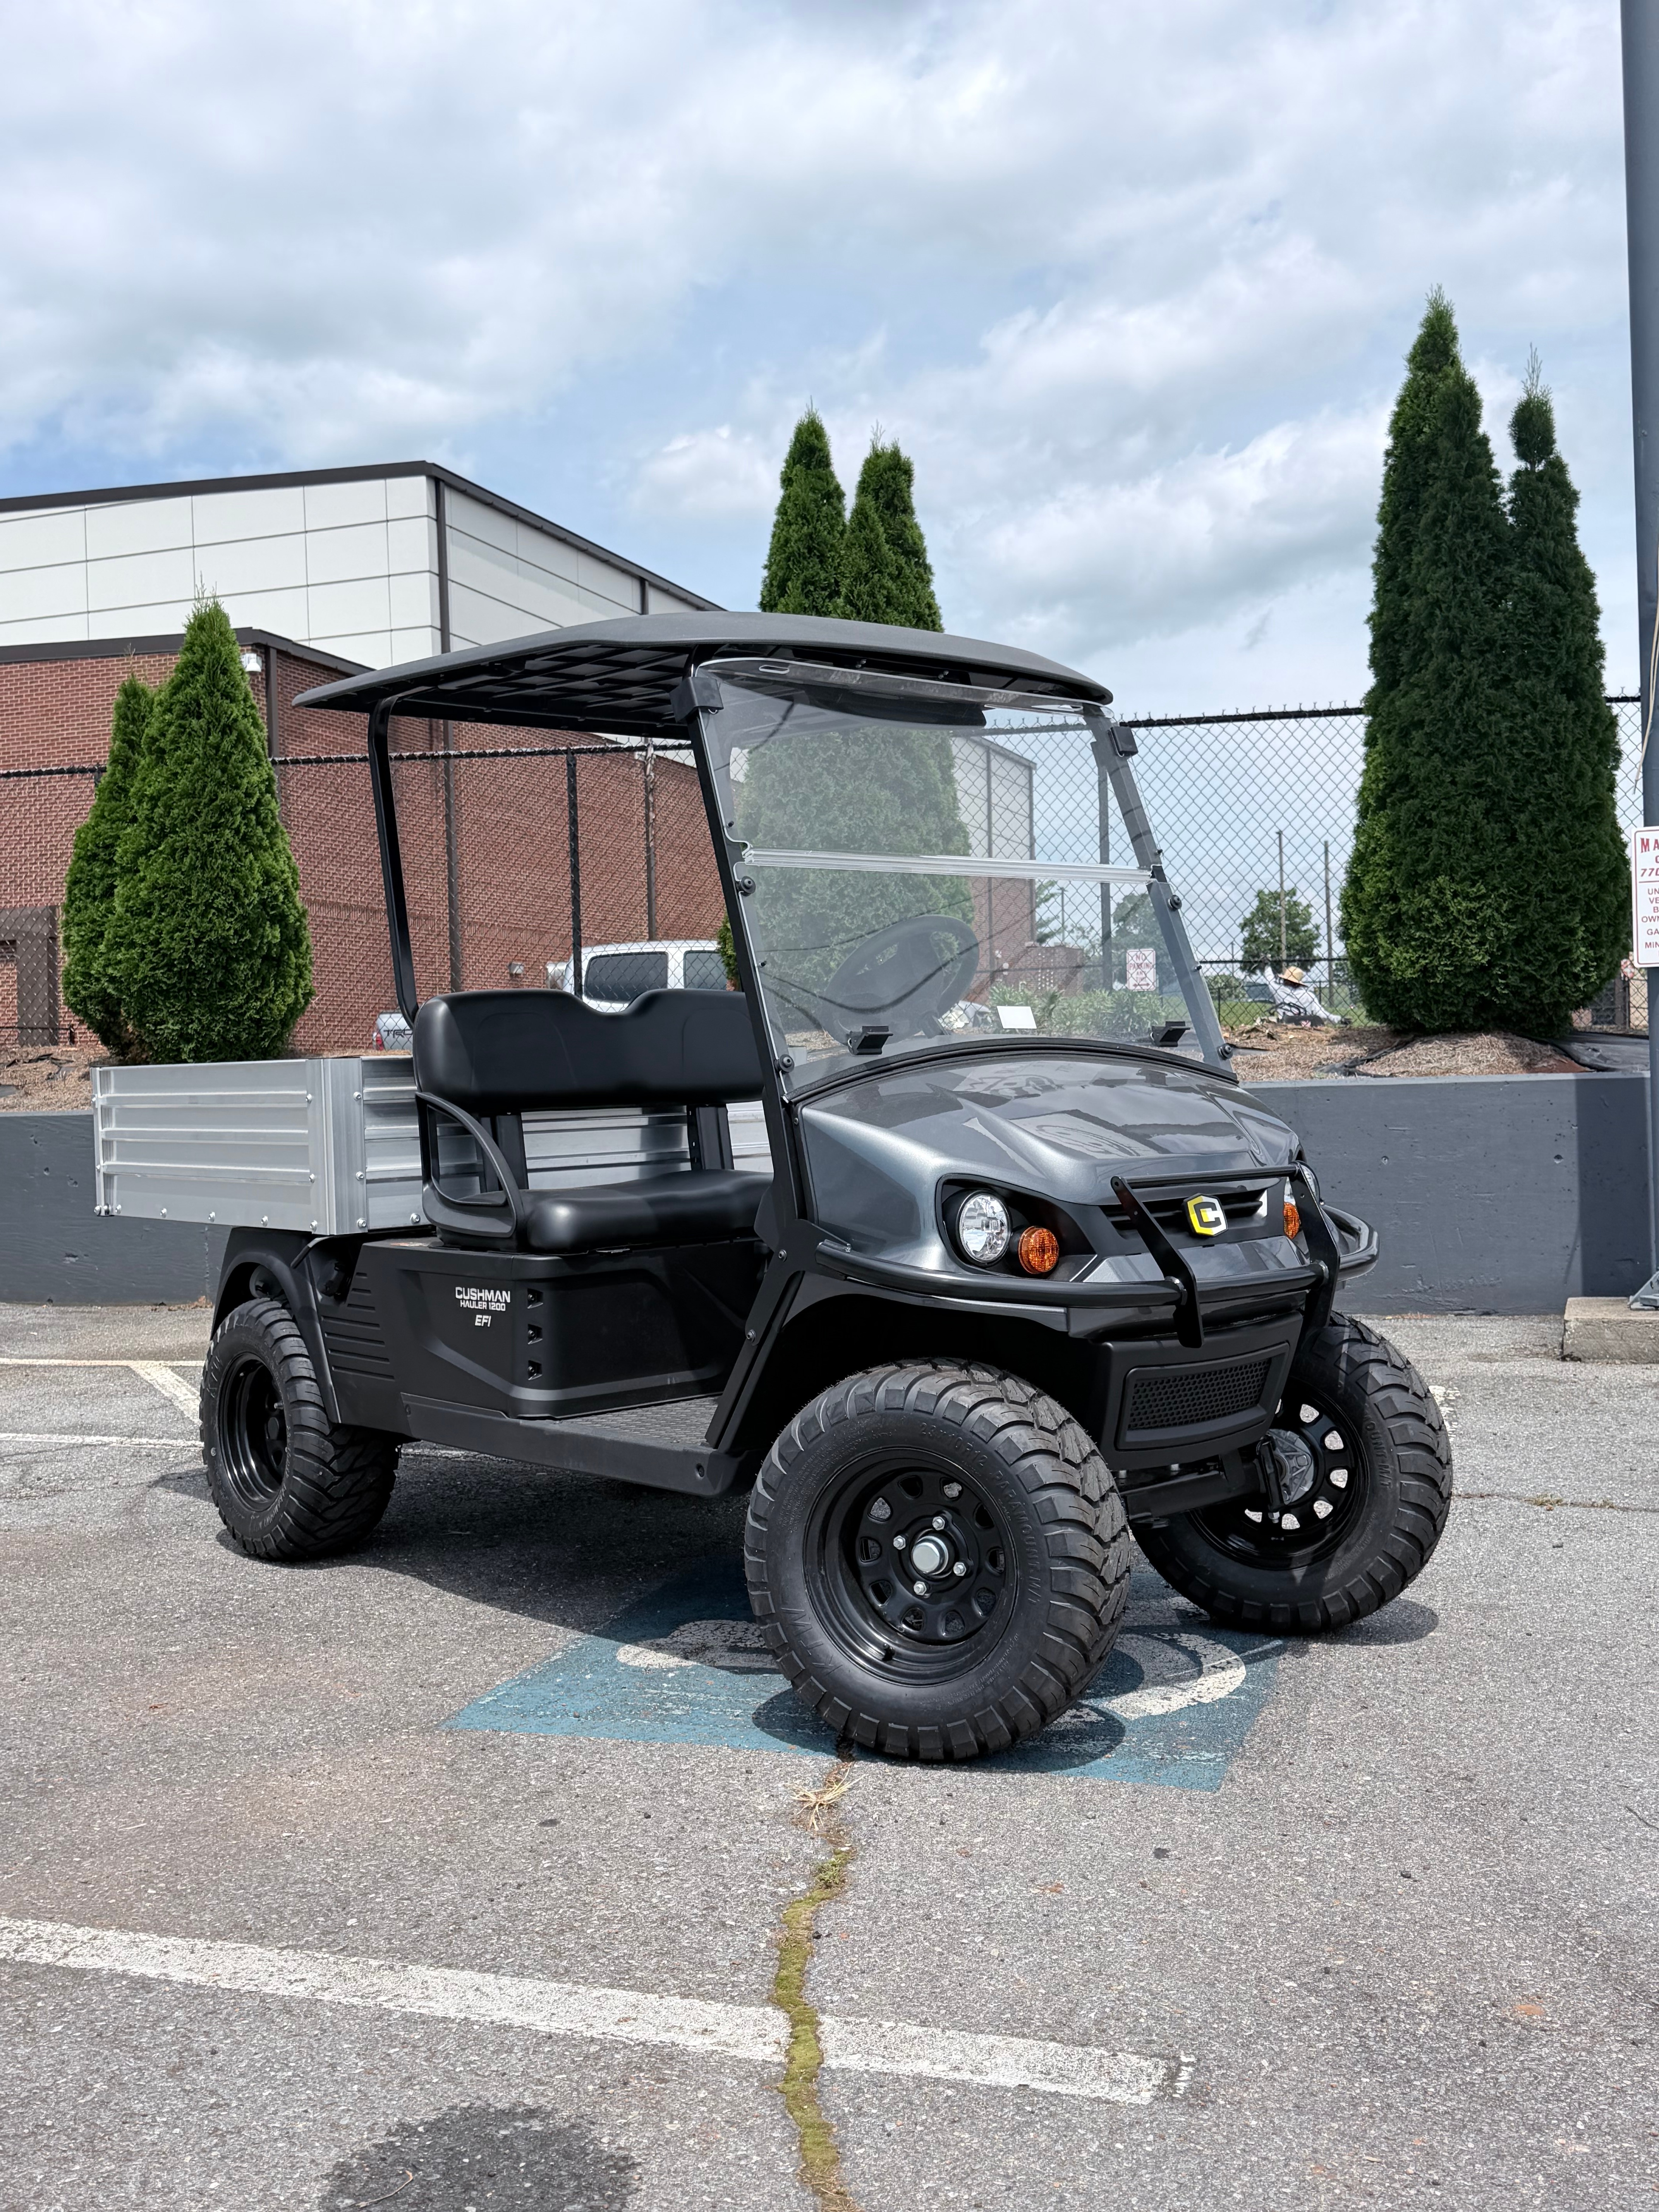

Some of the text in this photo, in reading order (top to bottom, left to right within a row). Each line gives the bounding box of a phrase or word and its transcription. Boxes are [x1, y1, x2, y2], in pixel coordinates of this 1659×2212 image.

[1640, 837, 1659, 853] MA
[383, 1029, 413, 1038] TRD
[455, 1286, 511, 1303] CUSHMAN
[460, 1300, 506, 1311] HAULER 1200
[475, 1314, 492, 1327] EFI
